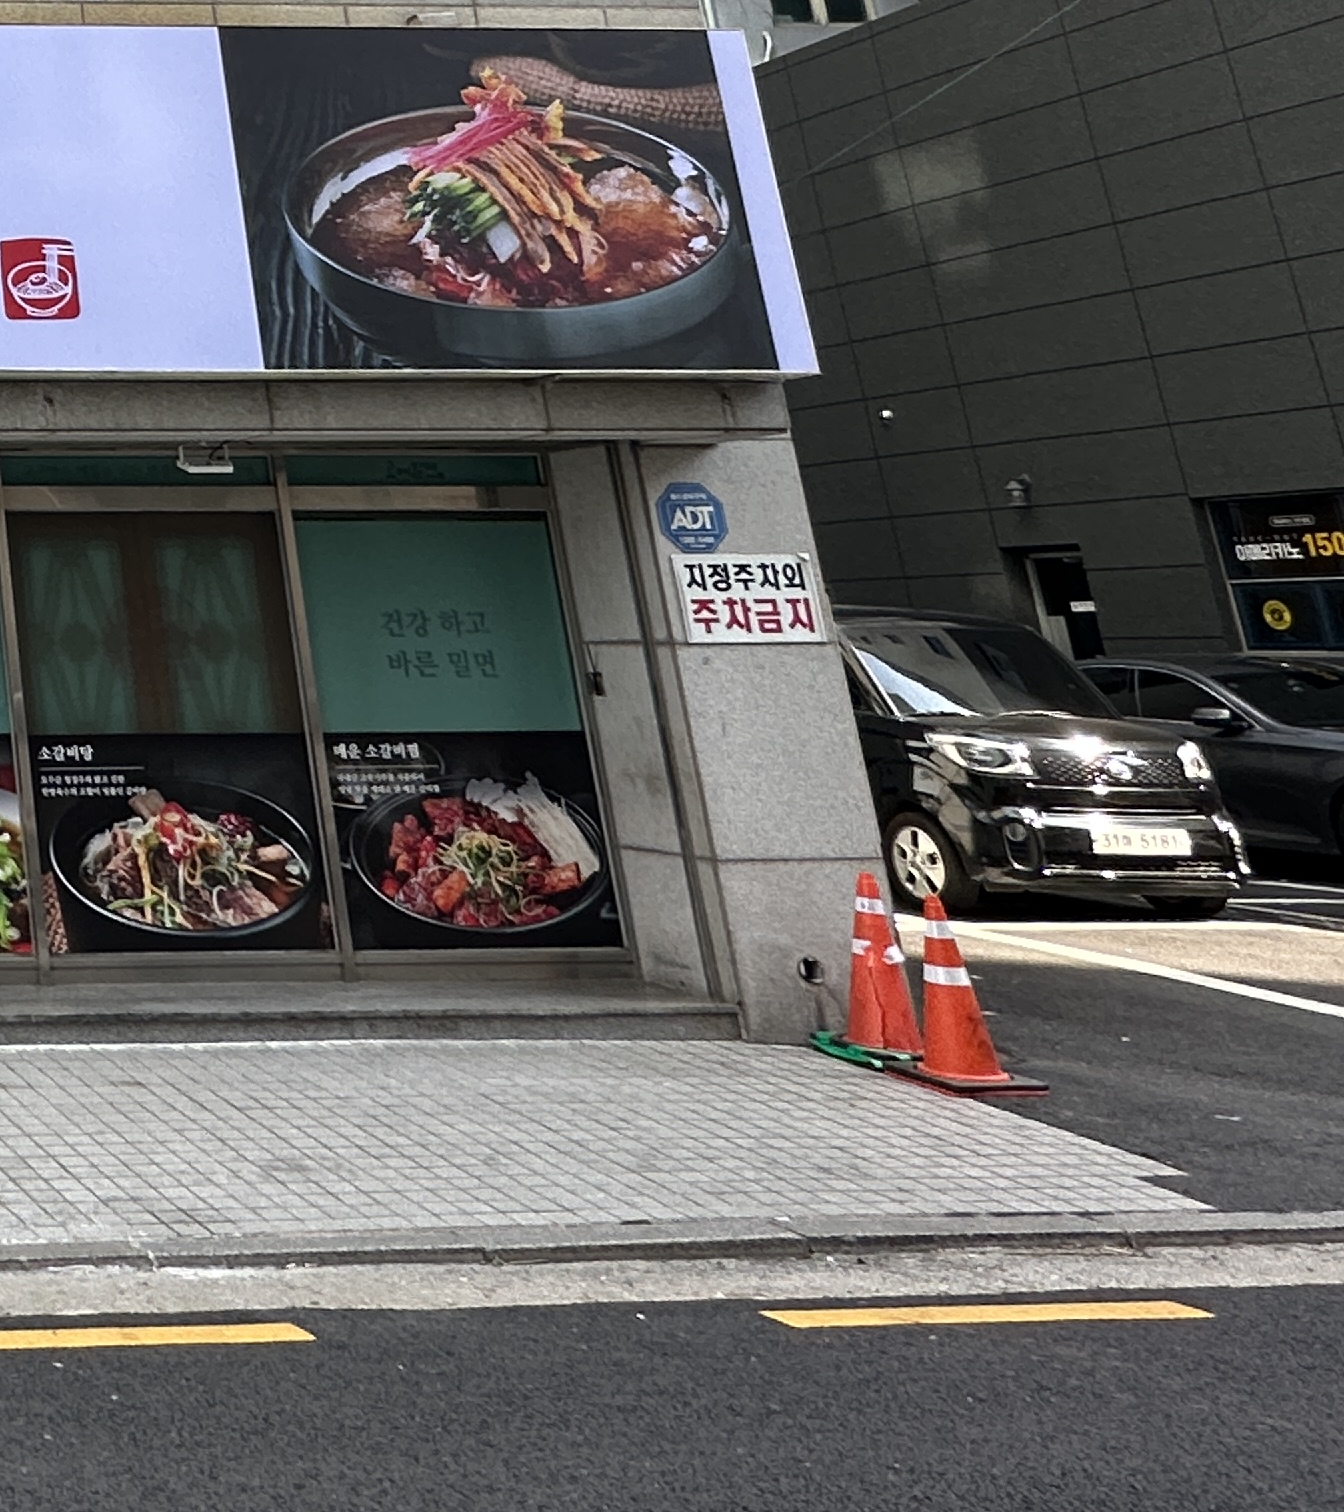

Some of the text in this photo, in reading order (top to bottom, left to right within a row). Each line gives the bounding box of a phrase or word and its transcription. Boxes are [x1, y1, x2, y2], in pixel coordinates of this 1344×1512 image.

[670, 505, 714, 530] ADT
[683, 562, 806, 592] 지정주차외
[380, 609, 491, 638] 건강 하고
[691, 597, 815, 634] 주차금지
[386, 649, 499, 678] 바른 밀면
